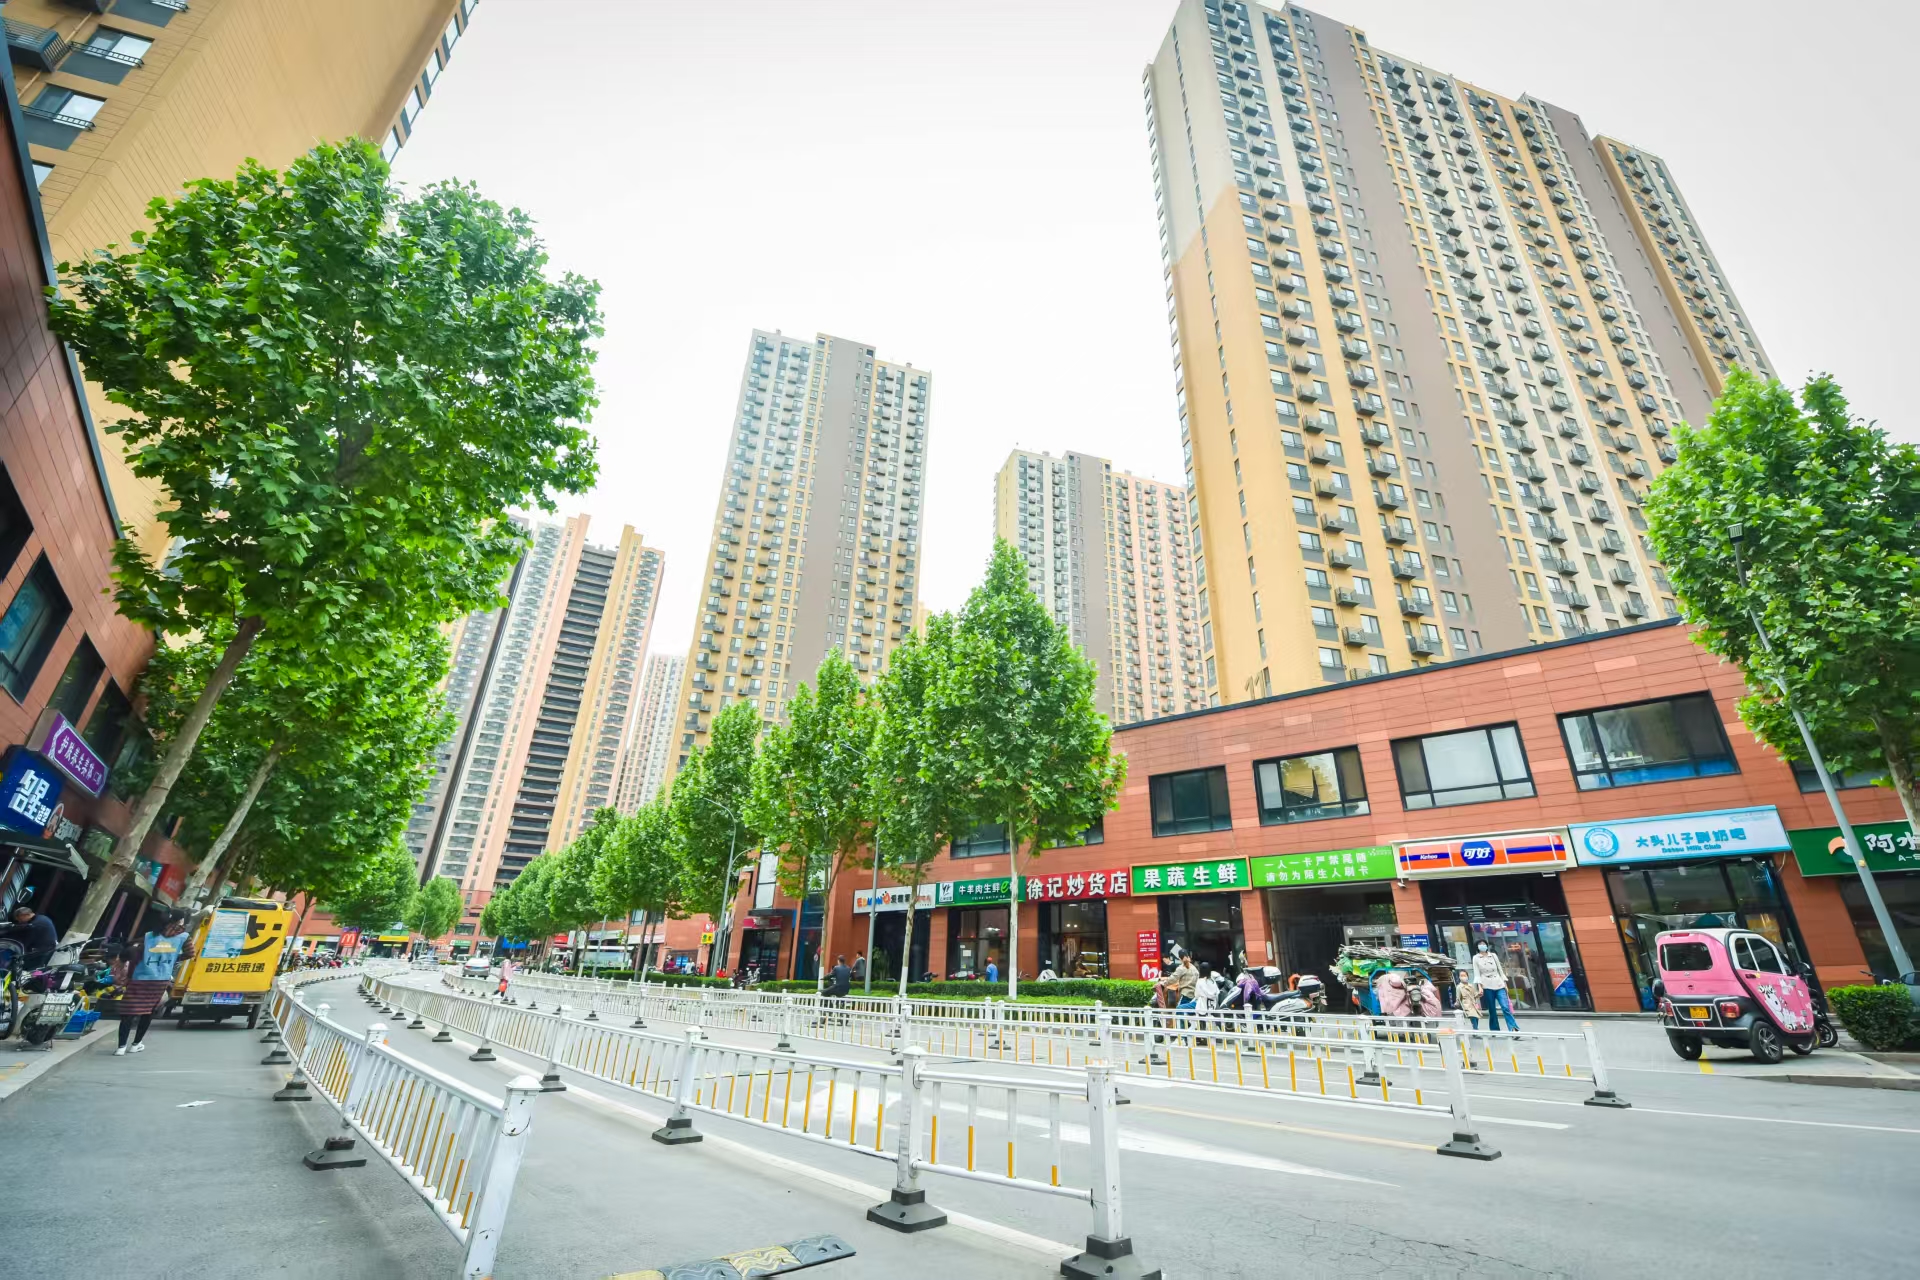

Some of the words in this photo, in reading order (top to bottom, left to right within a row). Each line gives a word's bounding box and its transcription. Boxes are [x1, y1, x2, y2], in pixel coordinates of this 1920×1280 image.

[1636, 828, 1747, 848] 大头儿子鲜奶吧
[1264, 852, 1368, 869] 一人一卡严禁尾随
[1463, 847, 1491, 859] 可好
[1143, 863, 1238, 889] 果蔬生鲜
[1265, 866, 1369, 883] 请勿为陌生人刷卡
[1026, 871, 1128, 900] 徐记炒货店
[205, 962, 266, 973] 韵达速递
